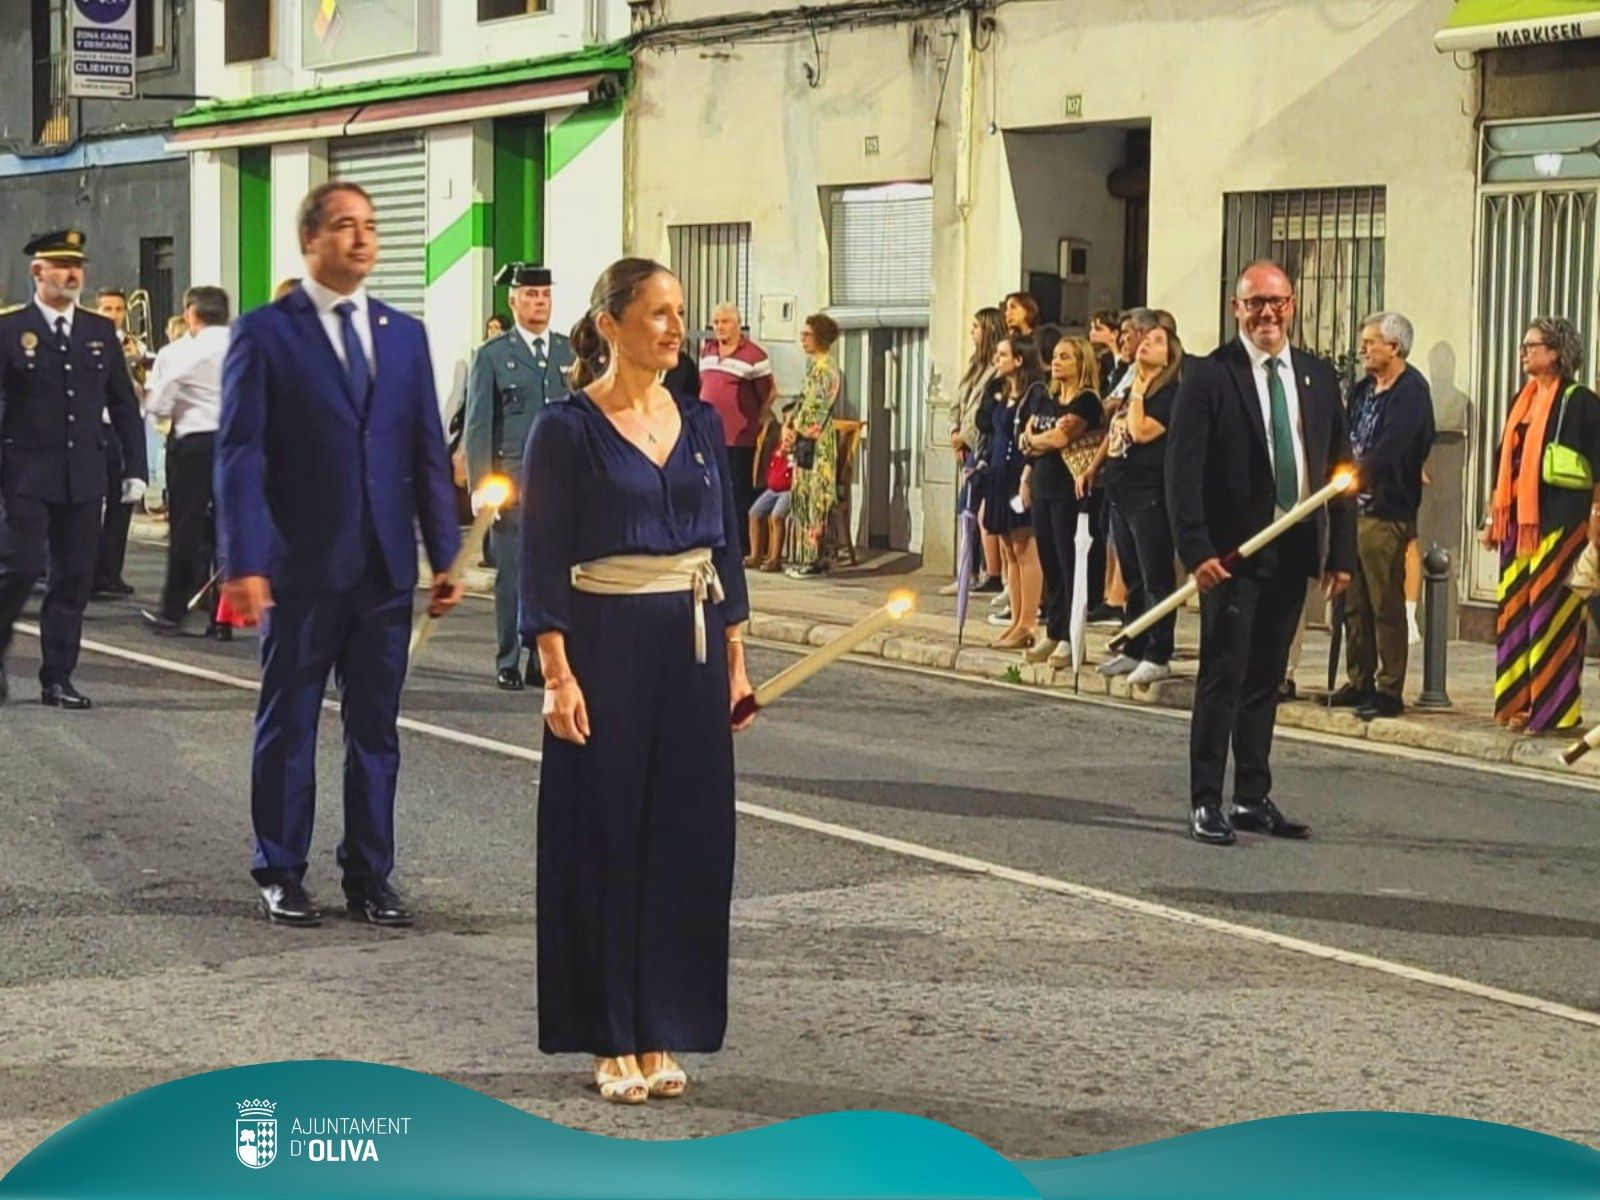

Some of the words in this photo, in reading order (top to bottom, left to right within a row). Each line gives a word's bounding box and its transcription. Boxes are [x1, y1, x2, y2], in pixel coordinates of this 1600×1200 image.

[75, 30, 99, 39] ZONA
[101, 31, 129, 40] CARGA
[1496, 22, 1582, 47] MARKISEN
[83, 40, 129, 49] DESCARGA
[75, 62, 130, 75] CLIENTES
